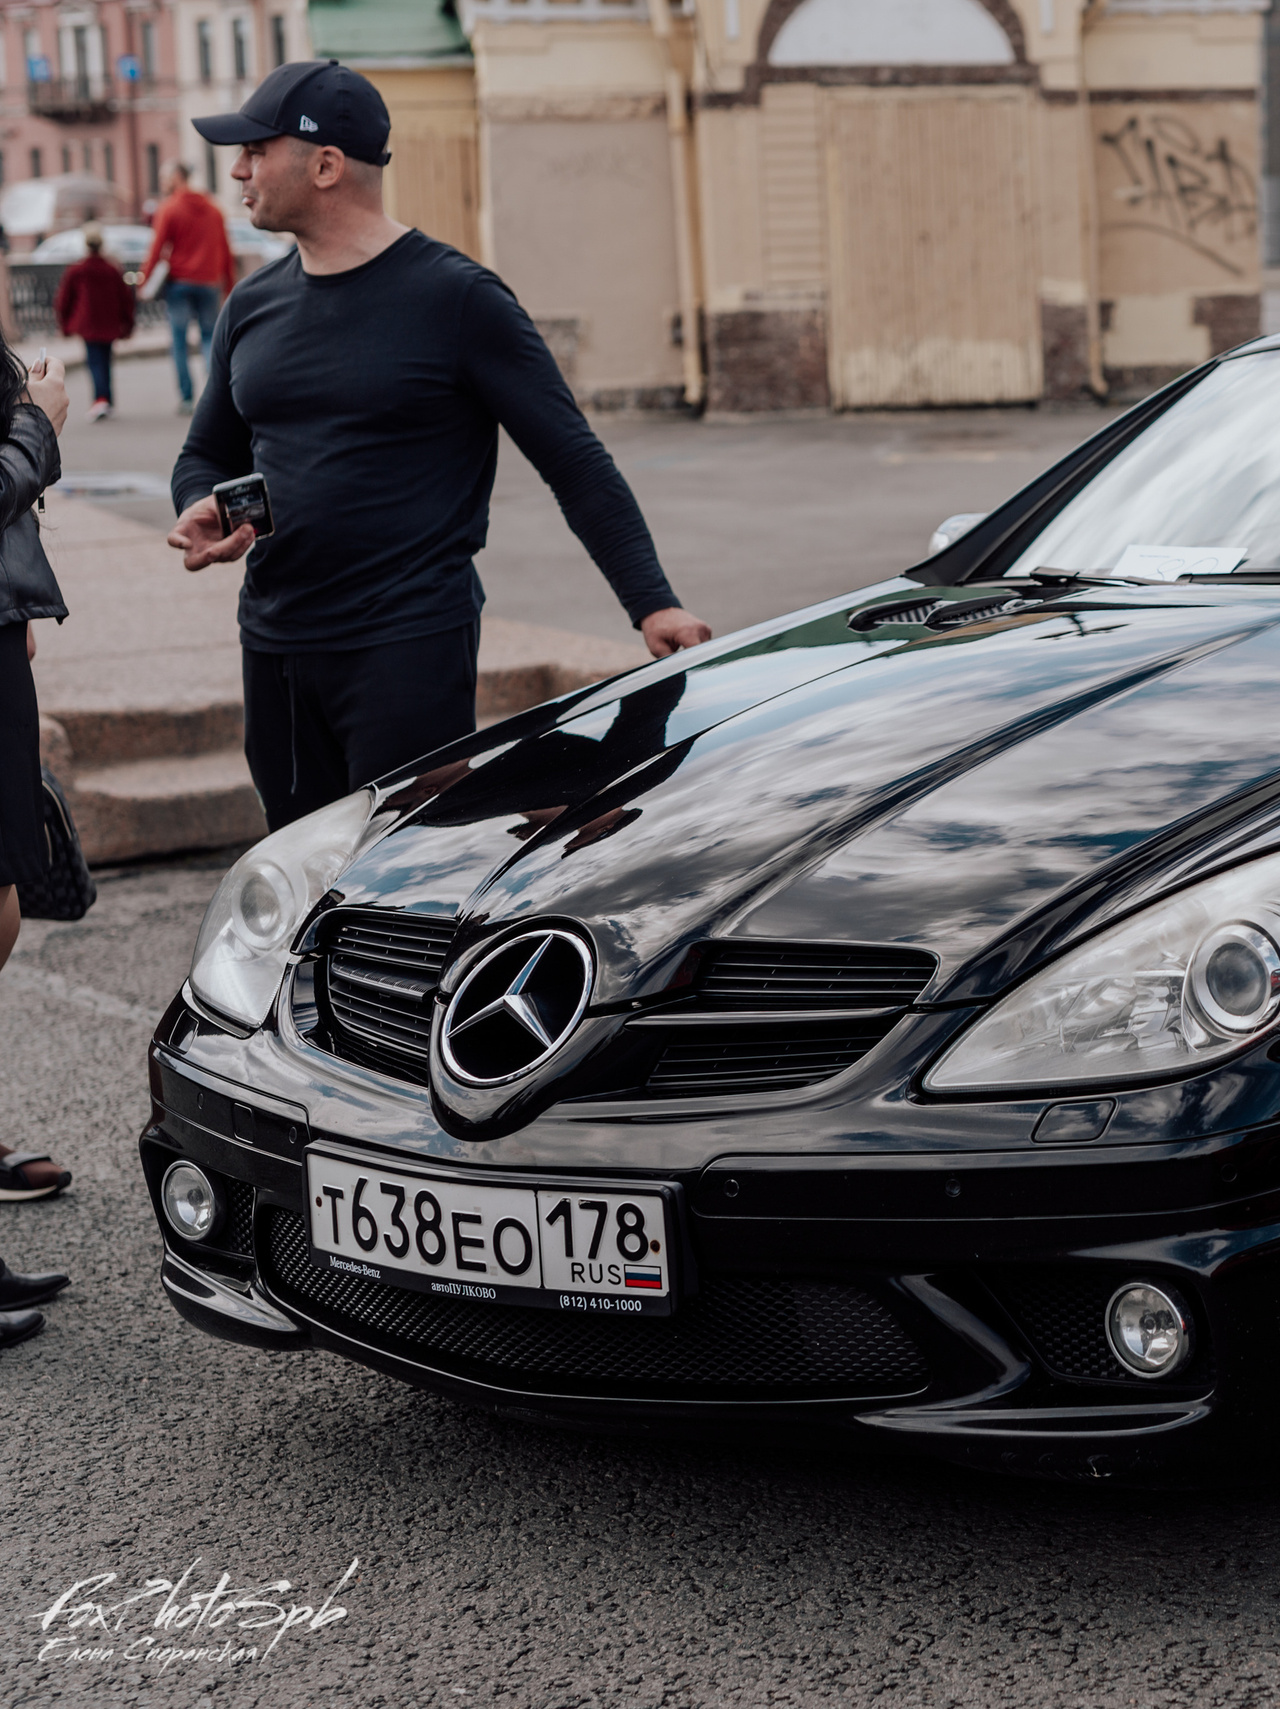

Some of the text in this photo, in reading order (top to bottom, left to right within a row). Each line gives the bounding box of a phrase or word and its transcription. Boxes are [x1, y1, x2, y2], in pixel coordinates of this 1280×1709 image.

[546, 1197, 648, 1261] 178
[329, 1255, 381, 1279] Mercedes-Benz
[571, 1262, 621, 1285] RUS
[431, 1282, 496, 1300] автоПУЛКОВО
[560, 1295, 642, 1312] (812) 410-1000
